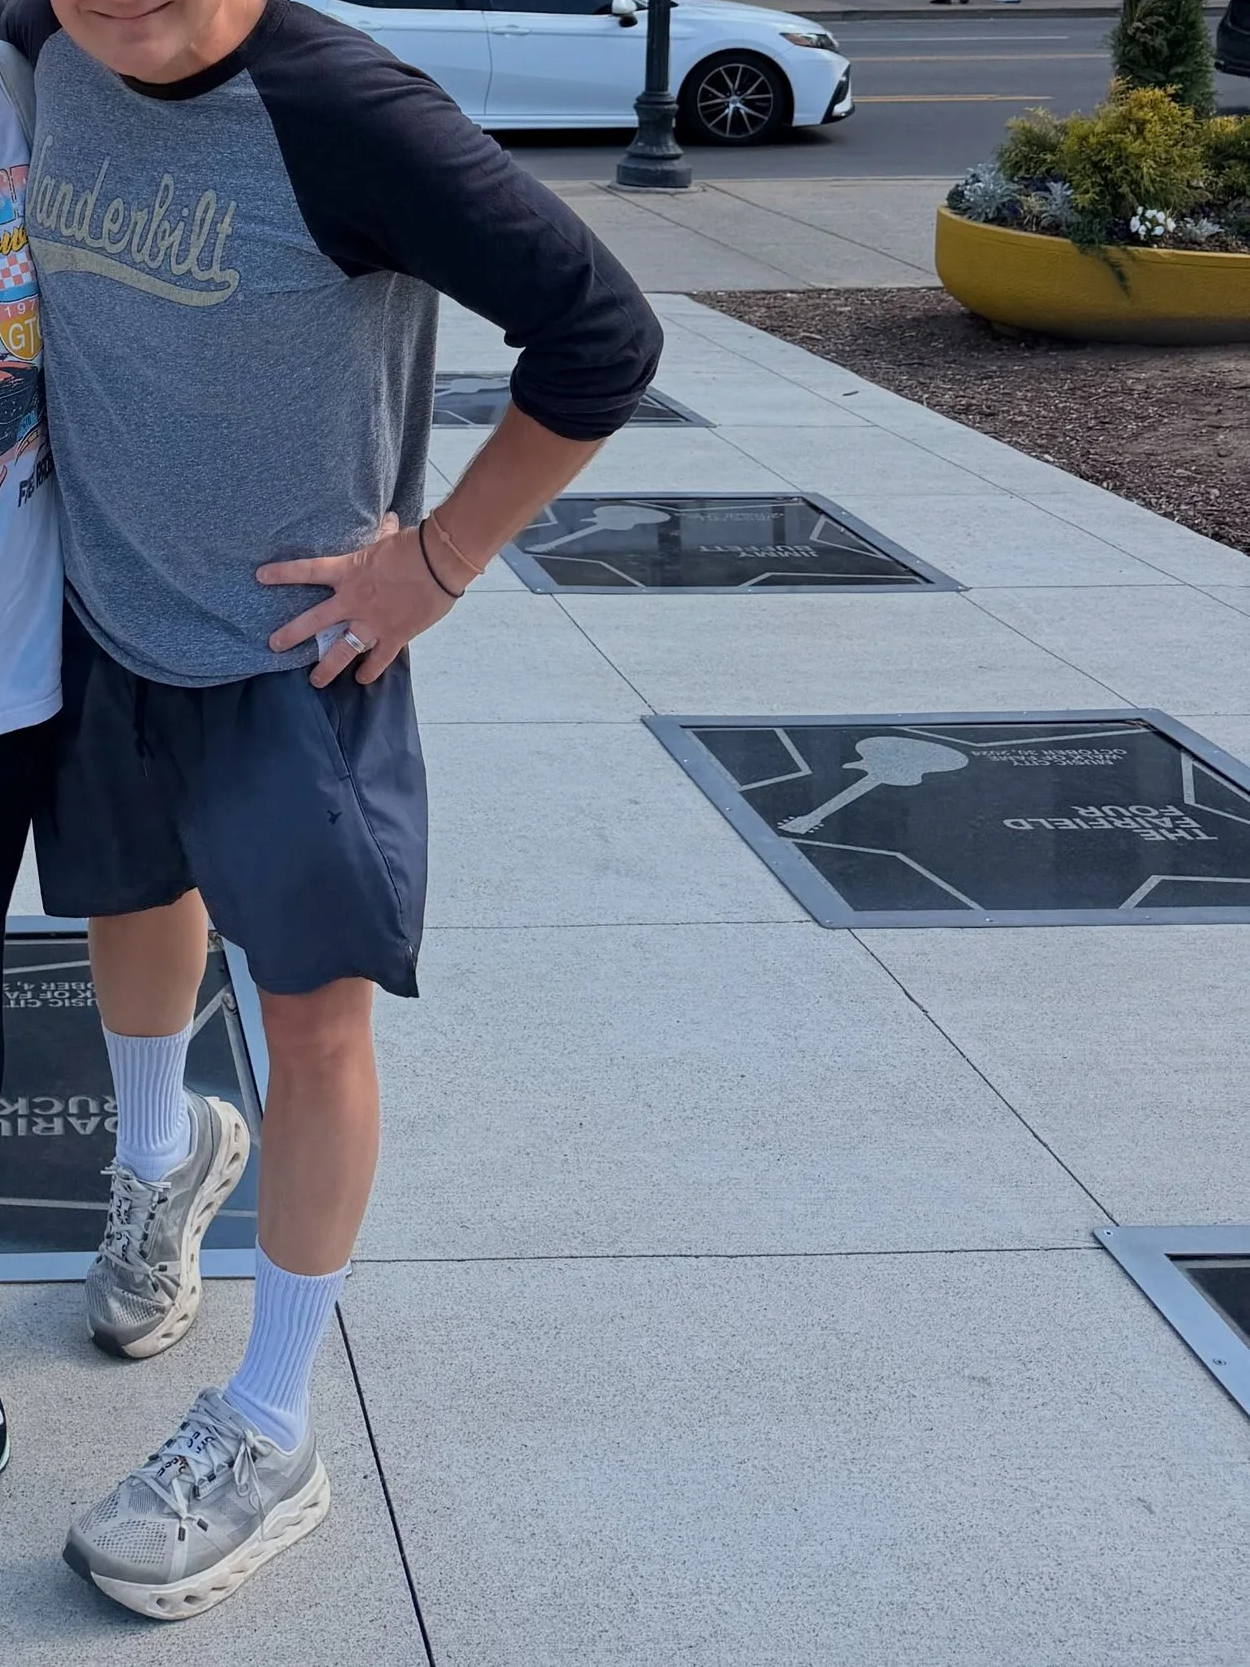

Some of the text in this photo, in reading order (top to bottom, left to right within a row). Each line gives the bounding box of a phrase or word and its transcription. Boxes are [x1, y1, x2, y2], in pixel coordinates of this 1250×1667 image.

[4, 299, 38, 318] 197
[7, 316, 44, 355] GT
[1070, 804, 1185, 817] FOUR
[1002, 816, 1203, 830] FAIRFIELD
[1132, 828, 1219, 841] THE
[4, 990, 32, 1000] FA
[39, 990, 70, 999] OF
[3, 998, 98, 1008] USIC CIT
